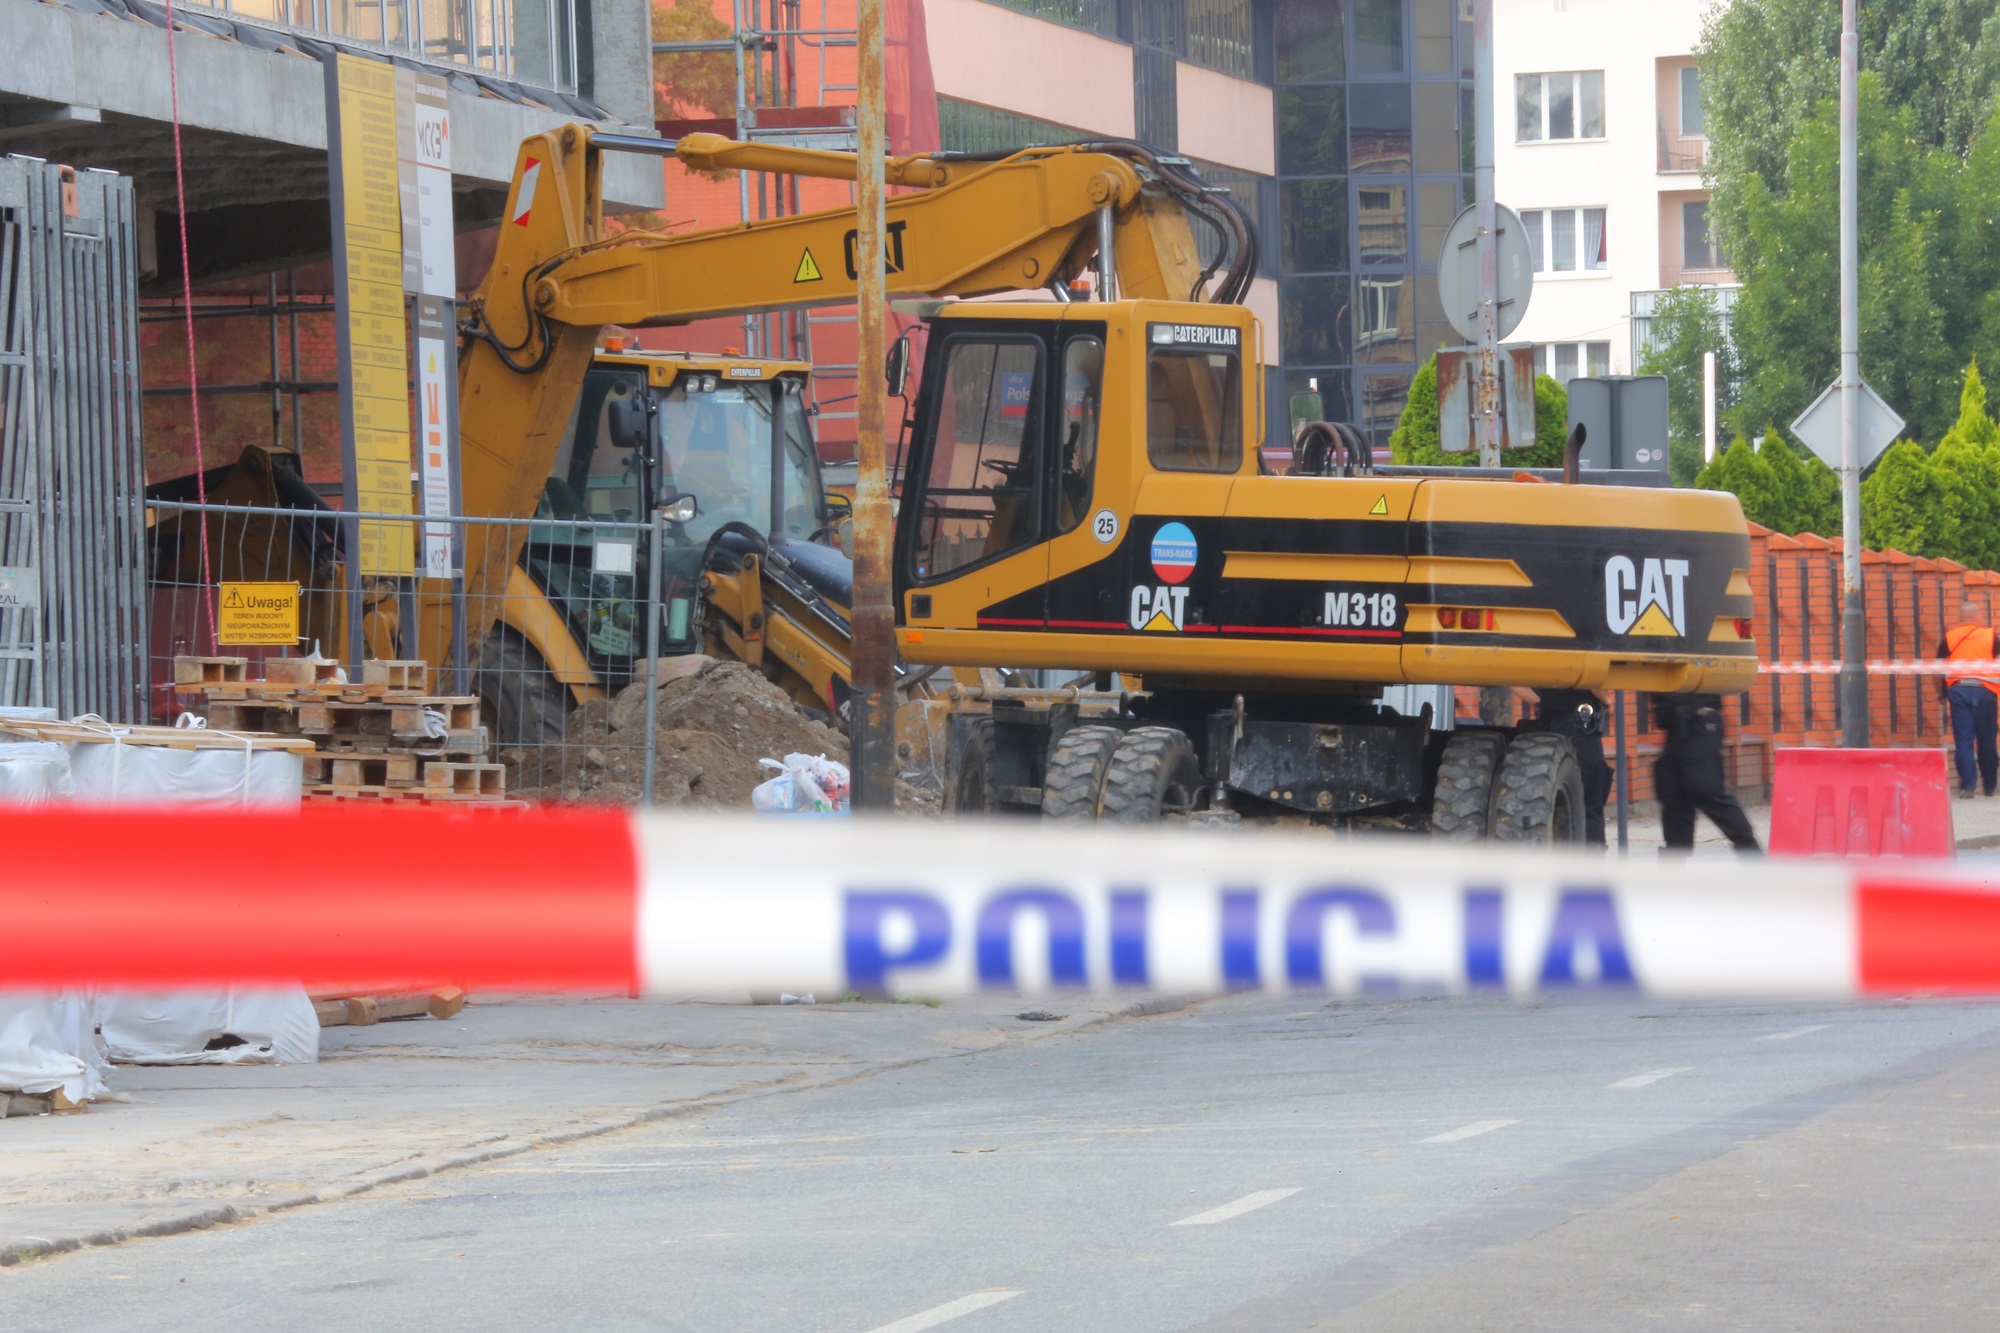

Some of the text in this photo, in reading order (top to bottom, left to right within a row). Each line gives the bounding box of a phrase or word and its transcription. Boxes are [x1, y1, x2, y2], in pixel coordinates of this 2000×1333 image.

[1173, 325, 1237, 345] CATERPILLAR
[1098, 518, 1114, 535] 25
[1154, 548, 1193, 559] TRANS-MARK
[247, 596, 293, 611] Uwaga!
[1604, 555, 1690, 637] CAT
[1130, 585, 1190, 631] CAT
[1324, 592, 1397, 627] M318
